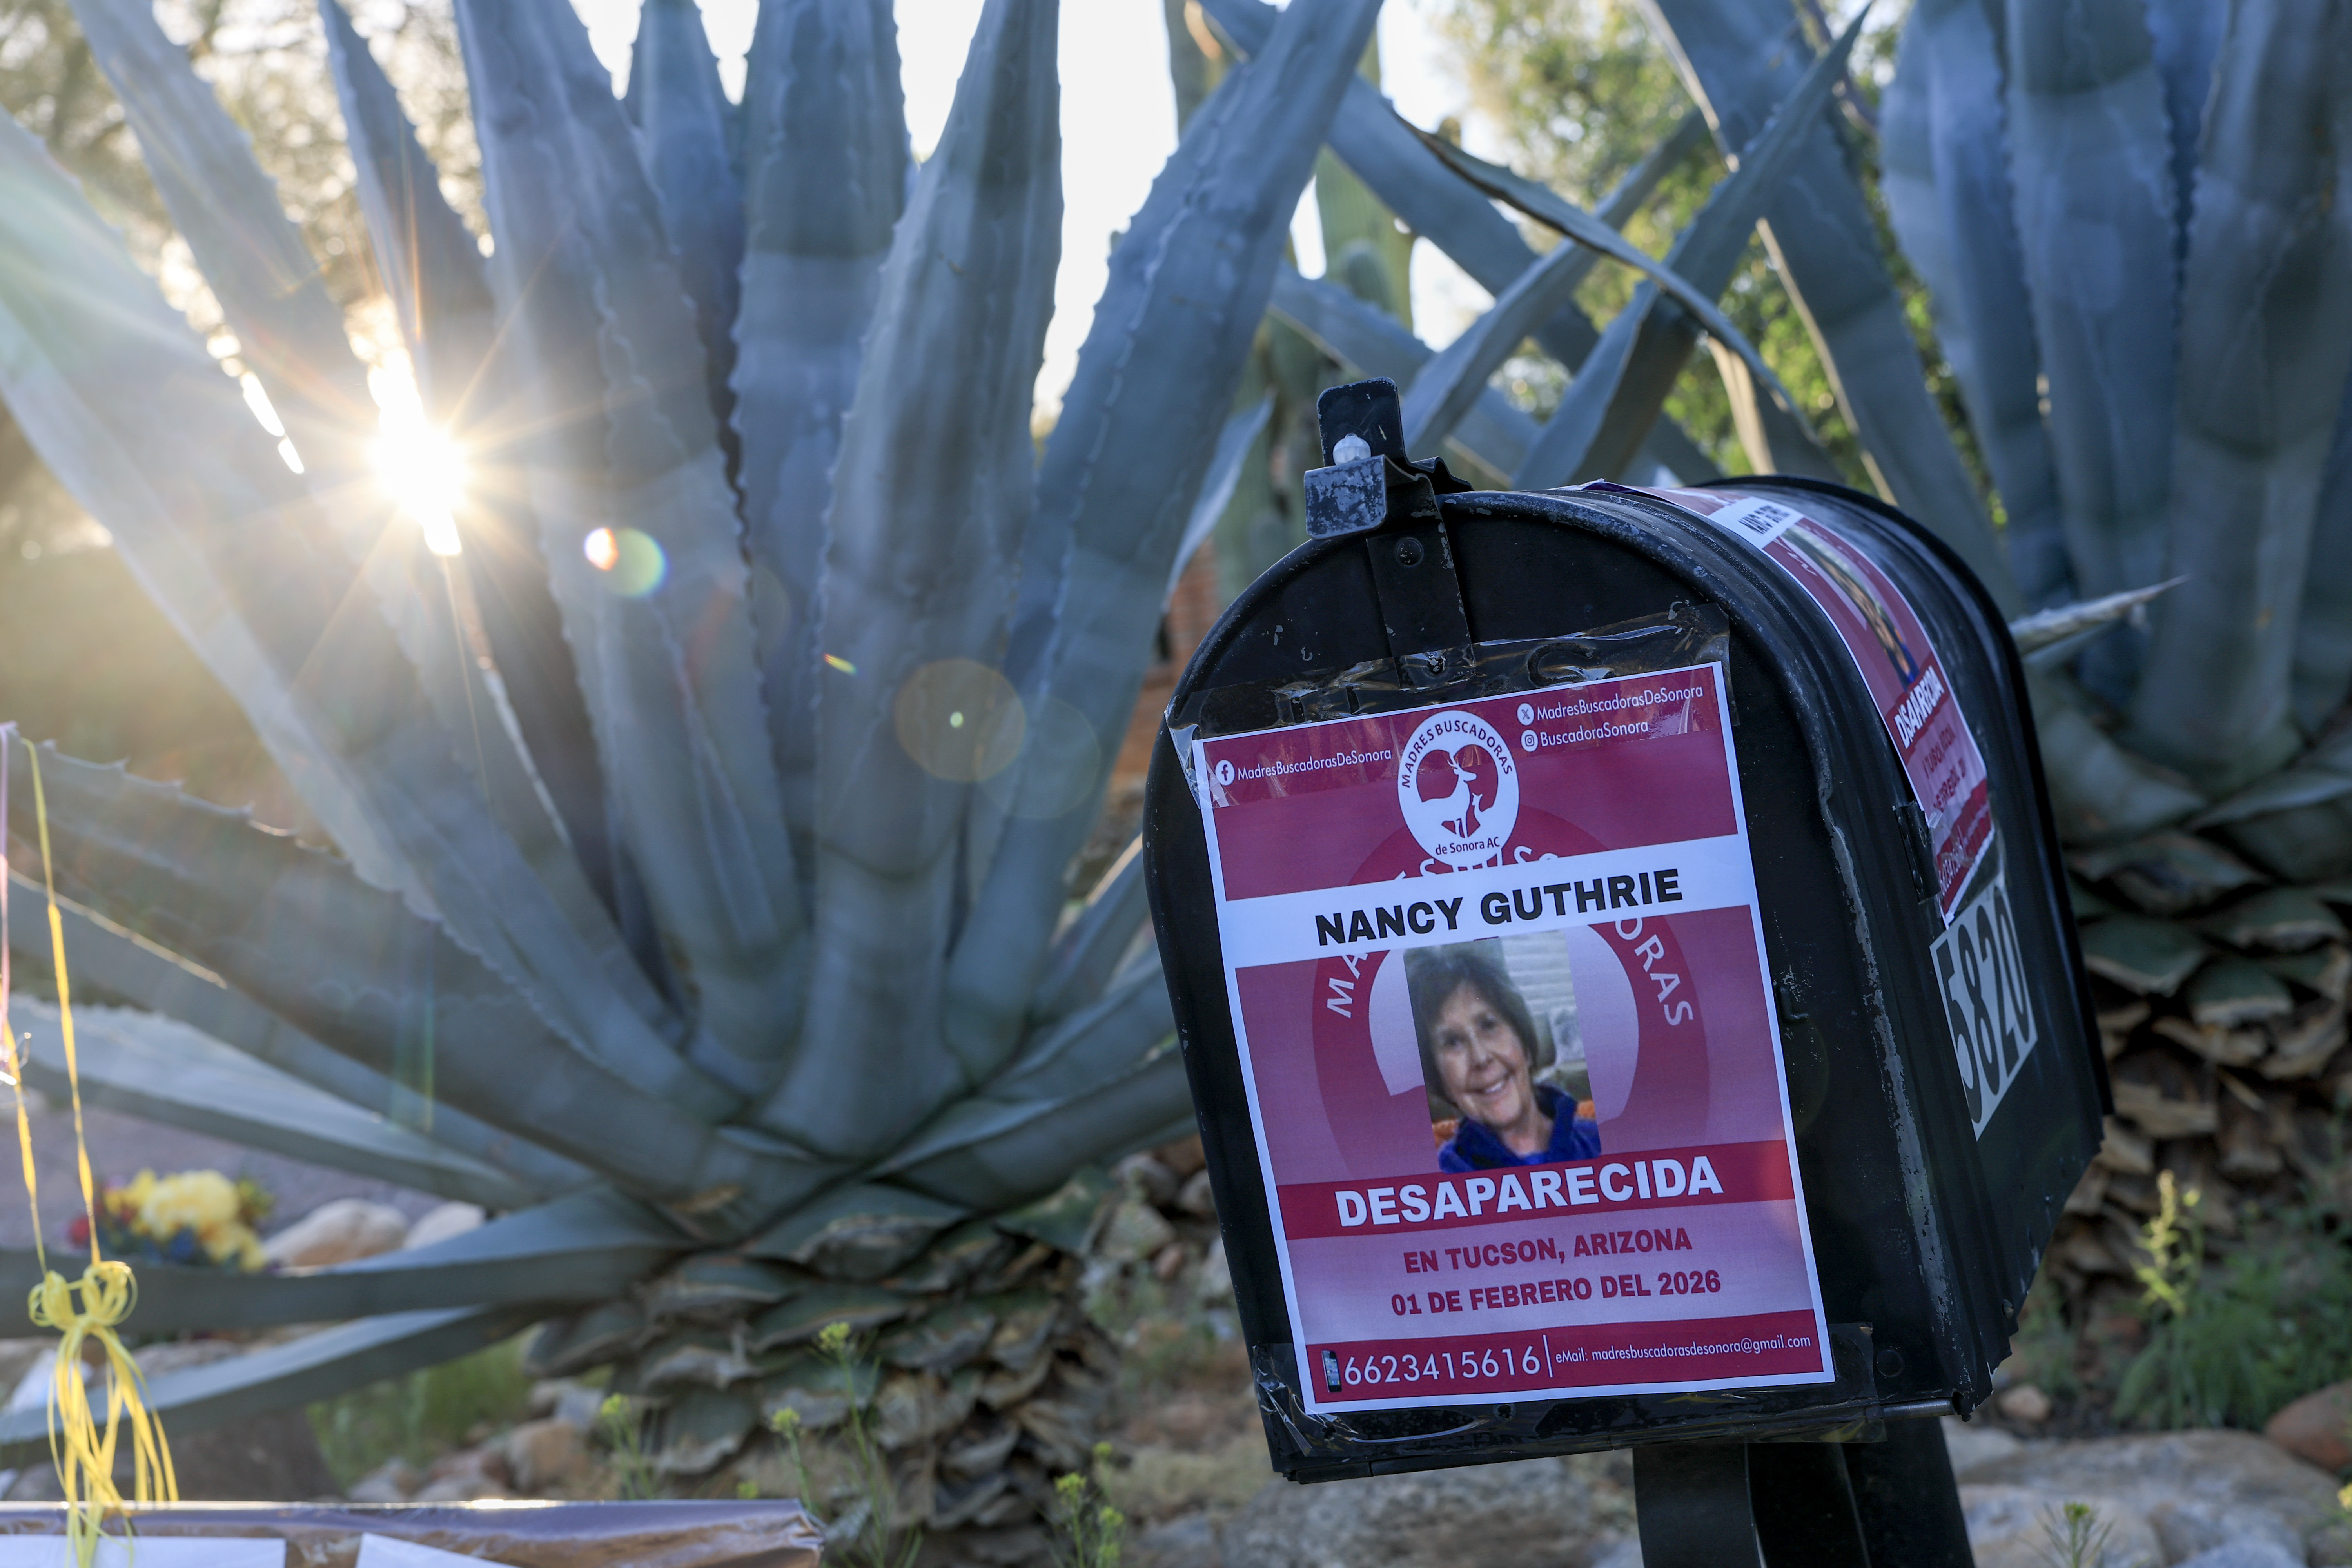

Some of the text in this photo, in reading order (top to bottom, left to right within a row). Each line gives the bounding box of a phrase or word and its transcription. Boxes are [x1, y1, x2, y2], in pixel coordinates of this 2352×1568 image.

[1537, 685, 1703, 721] MadresBuscadorasDeSonora
[1402, 720, 1513, 788] MADRES BUSCADORAS
[1541, 720, 1649, 747] BuscadoraSonora
[1238, 750, 1391, 780] MadresBuscadorasDeSonora
[1436, 837, 1500, 855] de Sonora AC
[1315, 897, 1464, 946] NANCY
[1480, 868, 1683, 925] GUTHRIE
[1936, 888, 2030, 1124] 5820
[1334, 1155, 1724, 1227] DESAPARECIDA
[1404, 1227, 1693, 1274] EN TUCSON, ARIZONA
[1391, 1269, 1721, 1316] 01 DE FEBRERO DEL 2026
[1344, 1334, 1811, 1385] 6623415616 eMail: madresbuscadorasdesonora@gmail.com
